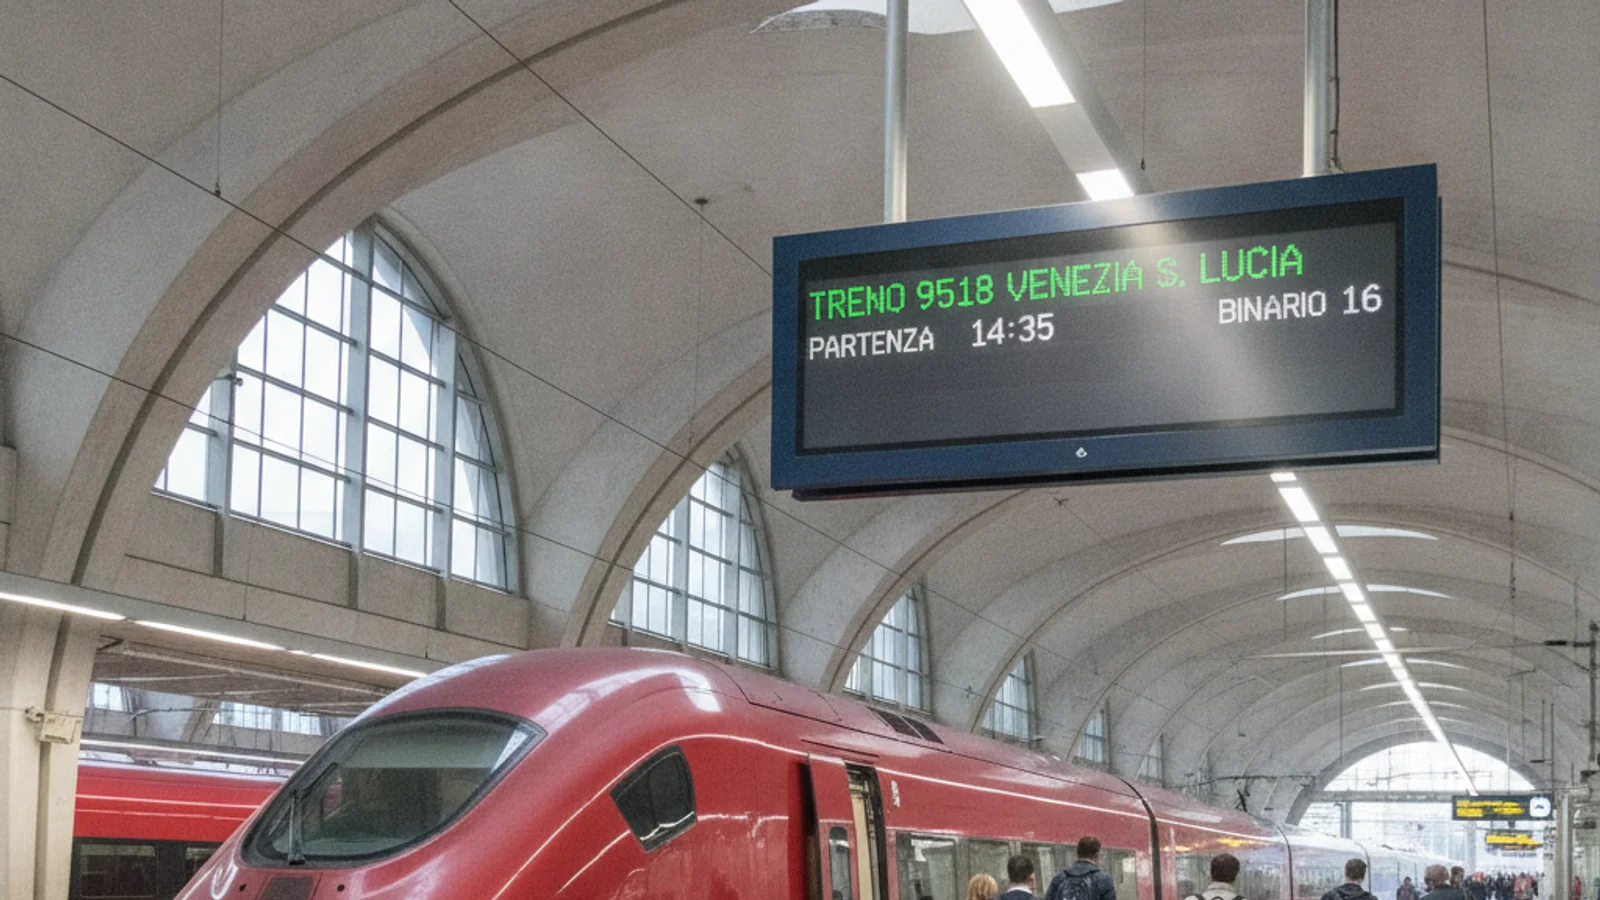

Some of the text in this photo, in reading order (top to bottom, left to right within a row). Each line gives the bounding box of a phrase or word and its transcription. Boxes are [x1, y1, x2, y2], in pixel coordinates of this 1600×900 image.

[808, 243, 1304, 321] TRENO 9518 VENEZIA S. LUCIA
[808, 282, 1383, 361] PARTENZA 14:35 BINARIO 16
